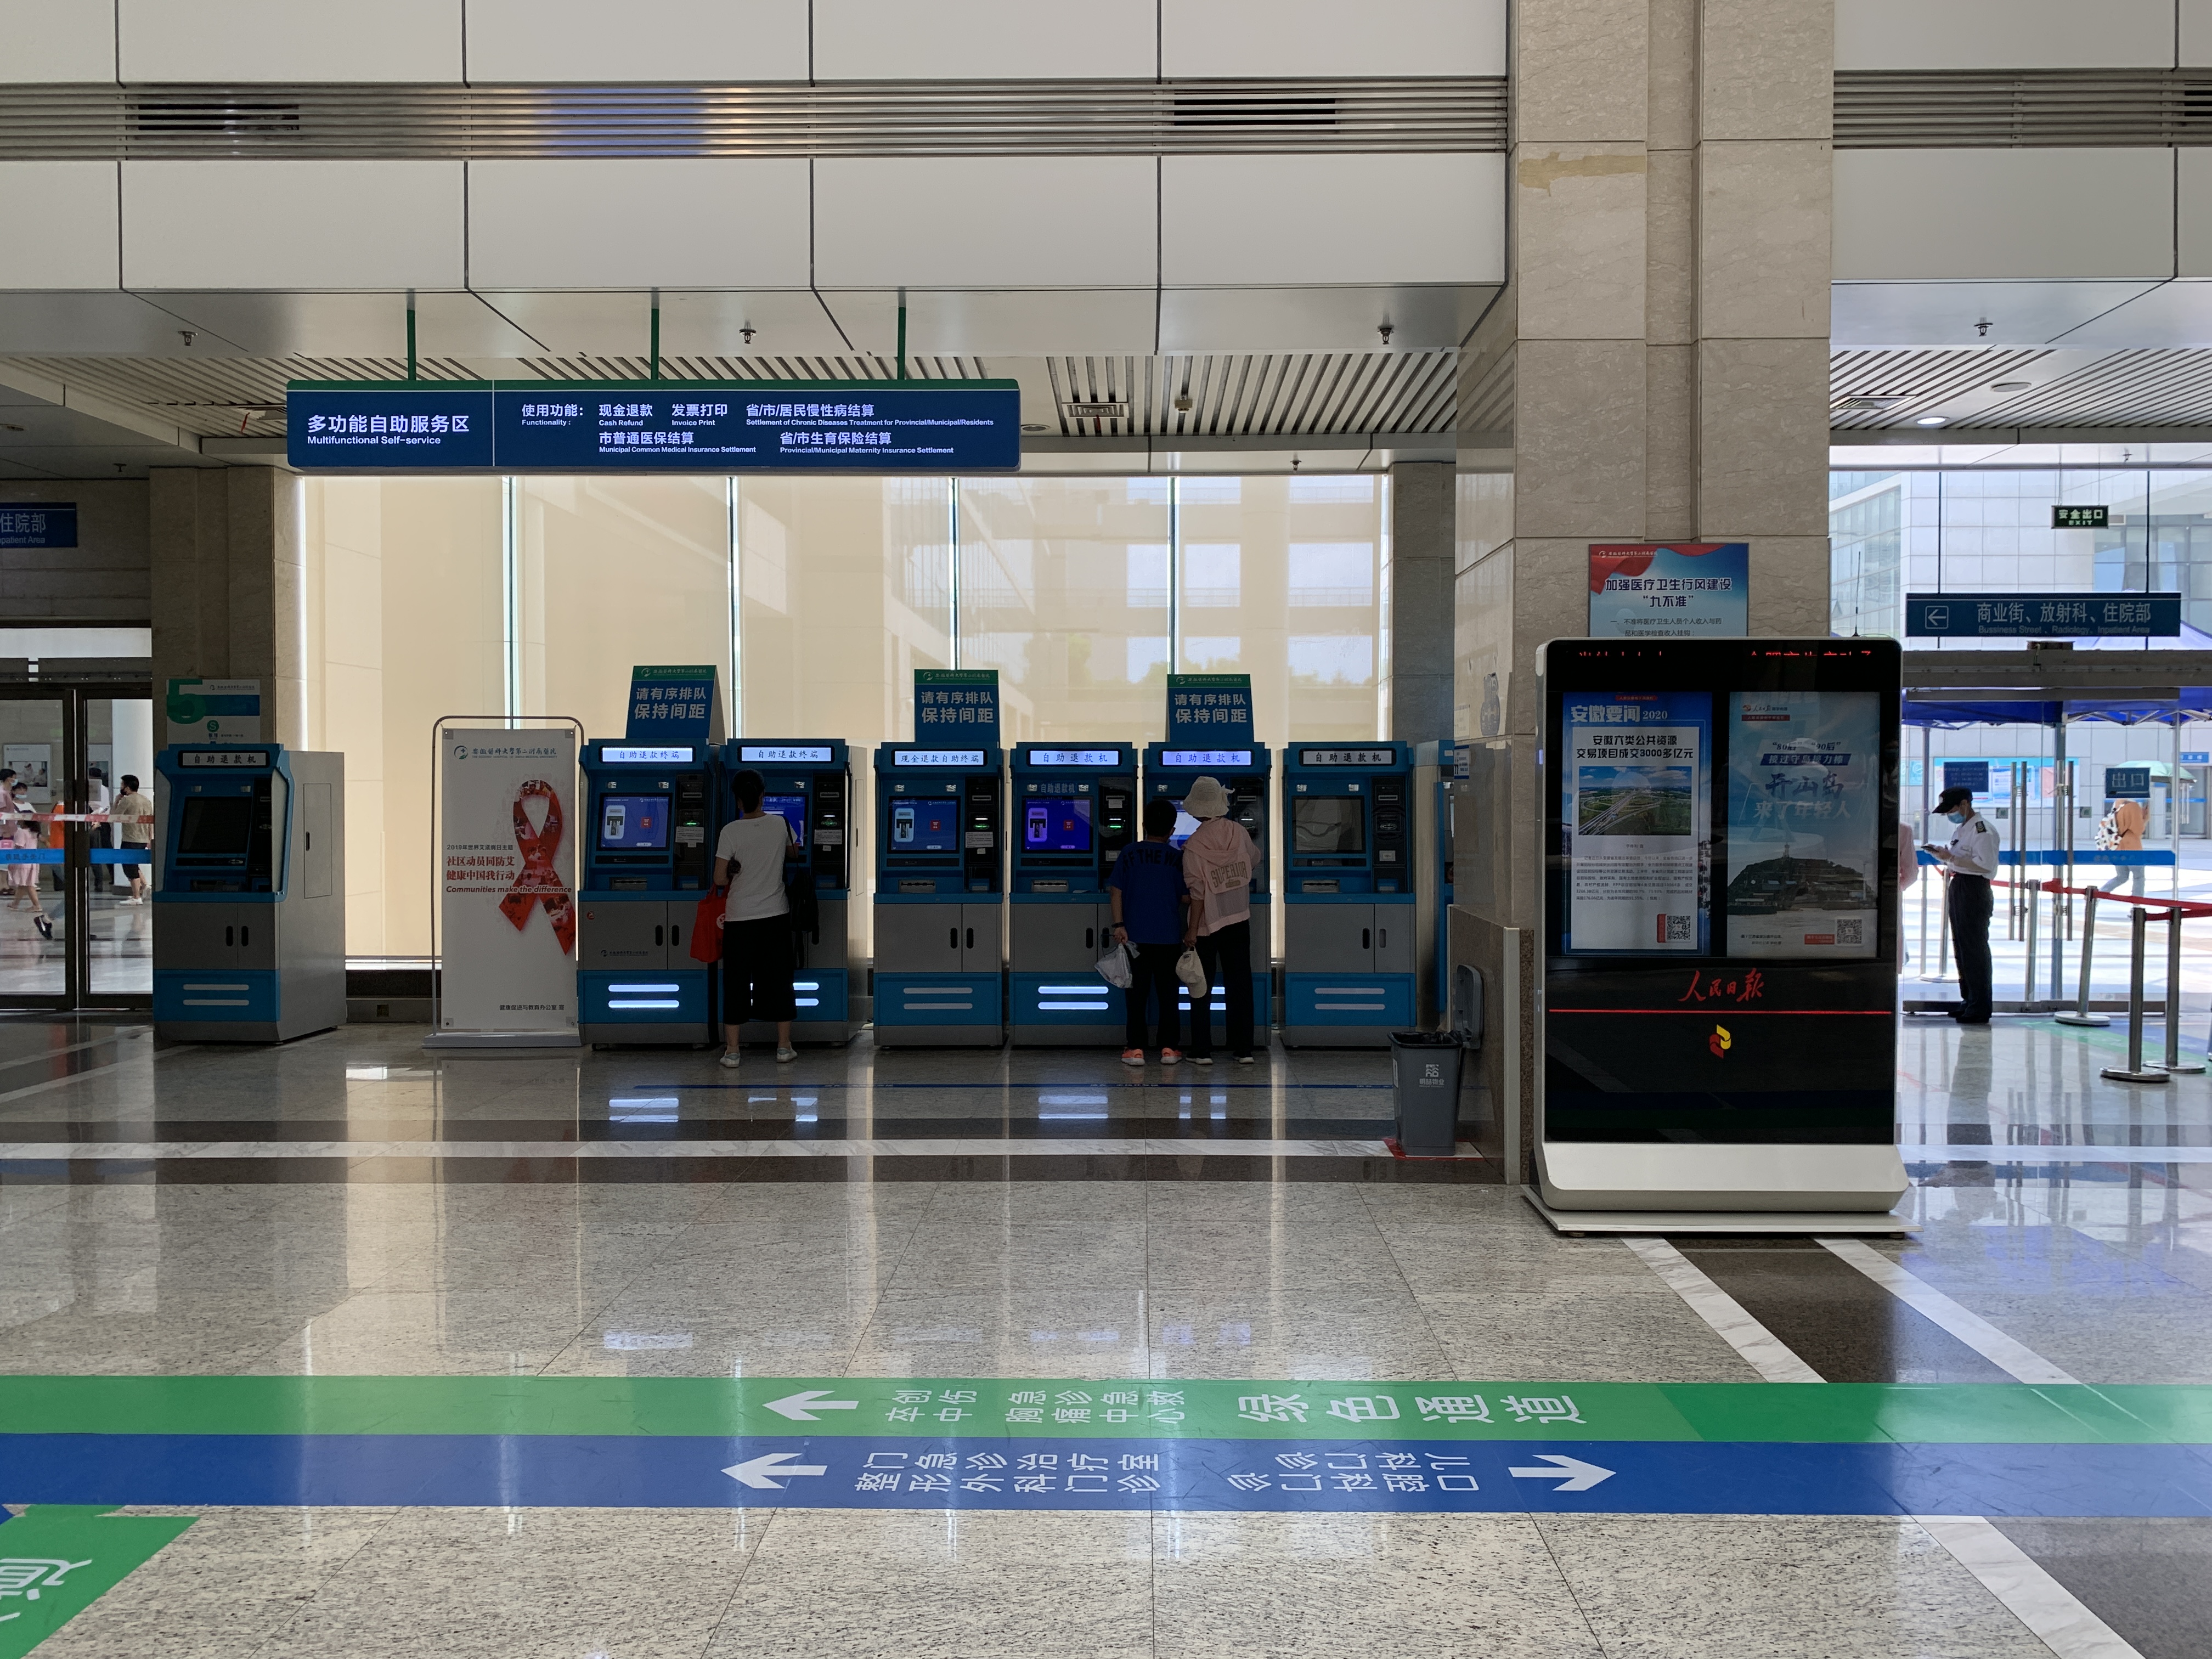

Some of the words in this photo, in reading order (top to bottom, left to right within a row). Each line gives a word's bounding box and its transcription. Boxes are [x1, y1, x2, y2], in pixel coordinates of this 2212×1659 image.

[599, 404, 653, 417] 现金退款
[672, 404, 727, 417] 发票打印
[746, 404, 874, 417] 省/市/居民慢性病结算
[308, 415, 470, 433] 多功能自助服务区
[307, 436, 379, 444] Multifunctional
[381, 436, 441, 444] Self-service
[599, 432, 694, 445] 市普通医保结算
[780, 432, 892, 445] 省/市生育保险结算
[2058, 509, 2103, 520] 安全出口
[0, 512, 46, 534] 住院部
[27, 536, 46, 544] Area
[1606, 579, 1733, 591] 加强医疗卫生行风建设
[636, 687, 707, 701] 请有序排队
[921, 691, 993, 704] 请有序排队
[1175, 693, 1246, 706] 请有序排队
[634, 703, 706, 720] 保持间距
[922, 707, 994, 724] 保持间距
[1175, 708, 1247, 724] 保持间距
[1571, 705, 1641, 723] 安徽要闻
[1642, 710, 1668, 720] 2020
[1593, 735, 1678, 746] 安徽六类公共资源
[194, 754, 256, 764] 自助退款机
[619, 750, 679, 759] 自助退款终端
[758, 749, 819, 759] 自助退款终端
[900, 754, 979, 763] 现金退款自助终端
[1043, 752, 1108, 763] 自助退款机
[1175, 753, 1240, 763] 自助退款机
[1316, 752, 1382, 763] 自助退款机
[1576, 748, 1694, 759] 交易项目成交3000多亿元
[2112, 772, 2145, 788] 出口
[1041, 783, 1075, 793] 自助退款机
[447, 856, 515, 867] 社区动员同防艾
[1136, 848, 1162, 865] THE
[446, 870, 515, 881] 健康中国我行动
[1210, 861, 1249, 888] SUPERIOR
[446, 885, 496, 893] Communities
[497, 885, 518, 893] make
[533, 885, 572, 893] difference
[1678, 968, 1765, 1003] 人民日报
[891, 1390, 977, 1405] 创伤
[1008, 1390, 1186, 1406] 急诊急救
[1238, 1393, 1587, 1424] 绿色通道
[886, 1407, 973, 1423] 卒中
[1005, 1408, 1187, 1424] 胸痛中心
[862, 1452, 1160, 1471] 门急诊治疗室
[854, 1472, 1161, 1494] 整形外科门诊
